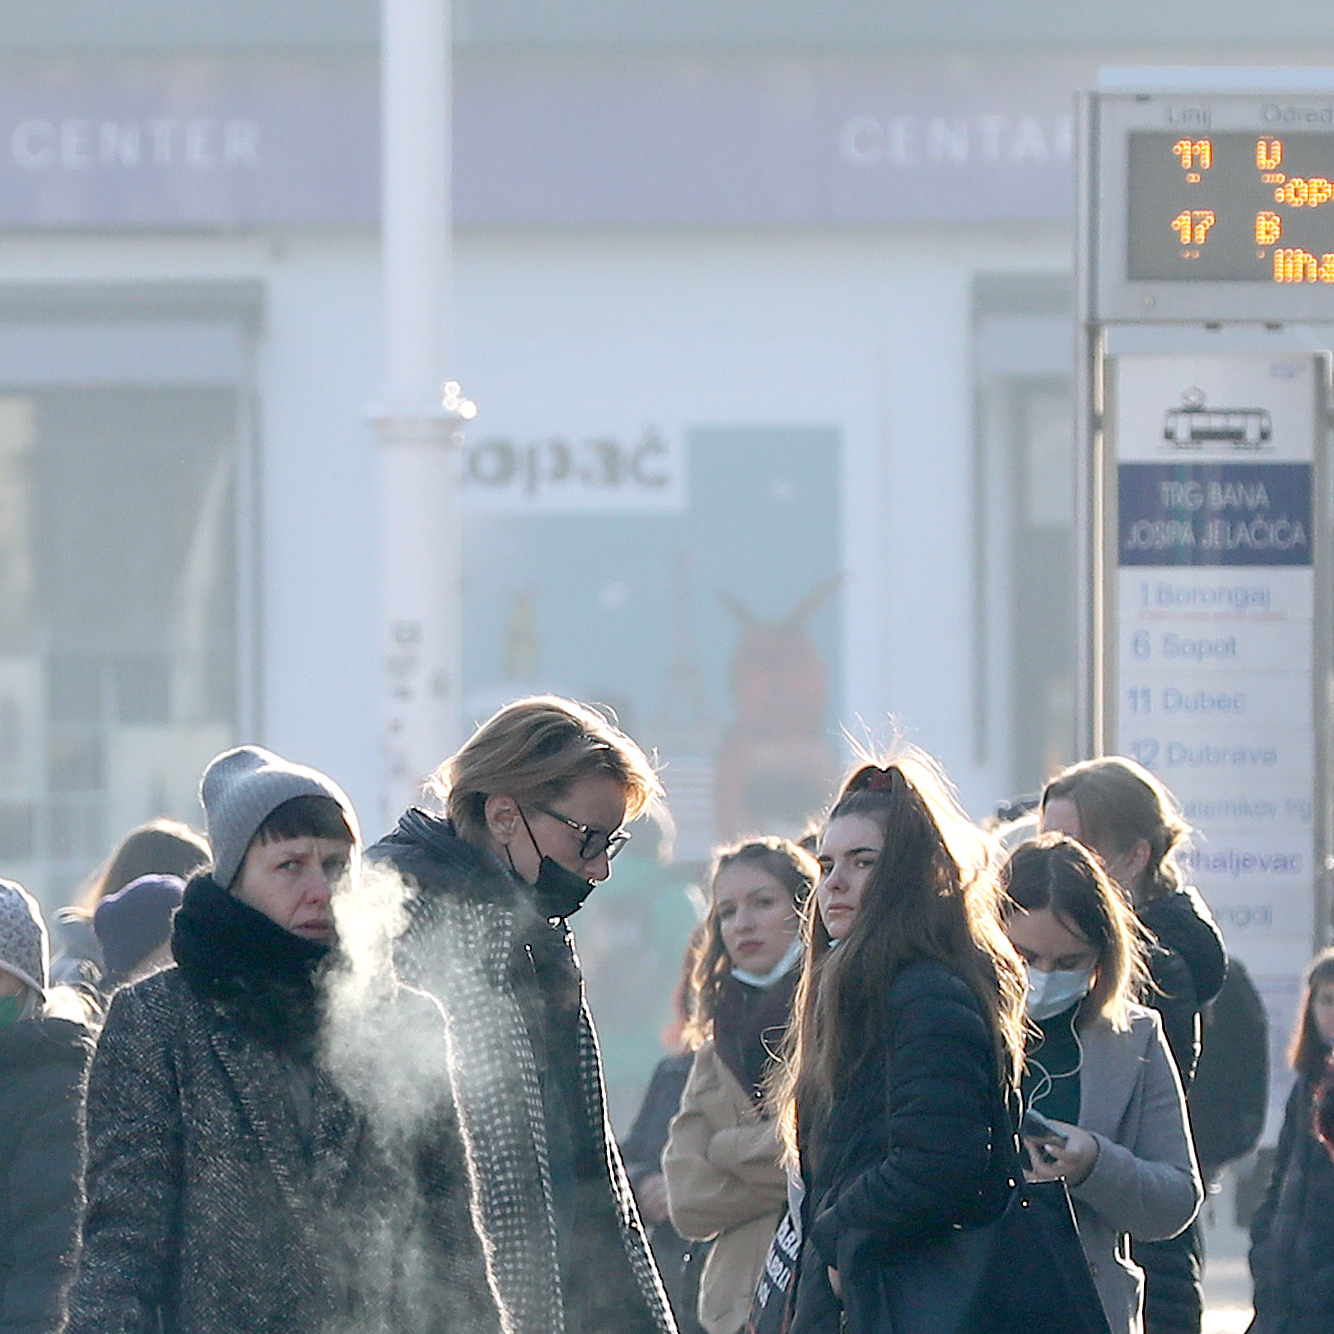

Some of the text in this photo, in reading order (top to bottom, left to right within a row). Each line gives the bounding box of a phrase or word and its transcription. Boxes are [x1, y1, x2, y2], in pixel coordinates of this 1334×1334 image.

[11, 117, 262, 171] CENTER
[1172, 137, 1213, 170] 11
[1171, 210, 1216, 245] 17
[1160, 481, 1271, 511] TRG BANA
[1128, 519, 1196, 550] JOSIPA
[1157, 582, 1271, 610] Borongaj
[1132, 628, 1237, 661] 6 Sopot
[1128, 685, 1246, 715] 11 Dubec
[1168, 740, 1278, 768] Dubrava
